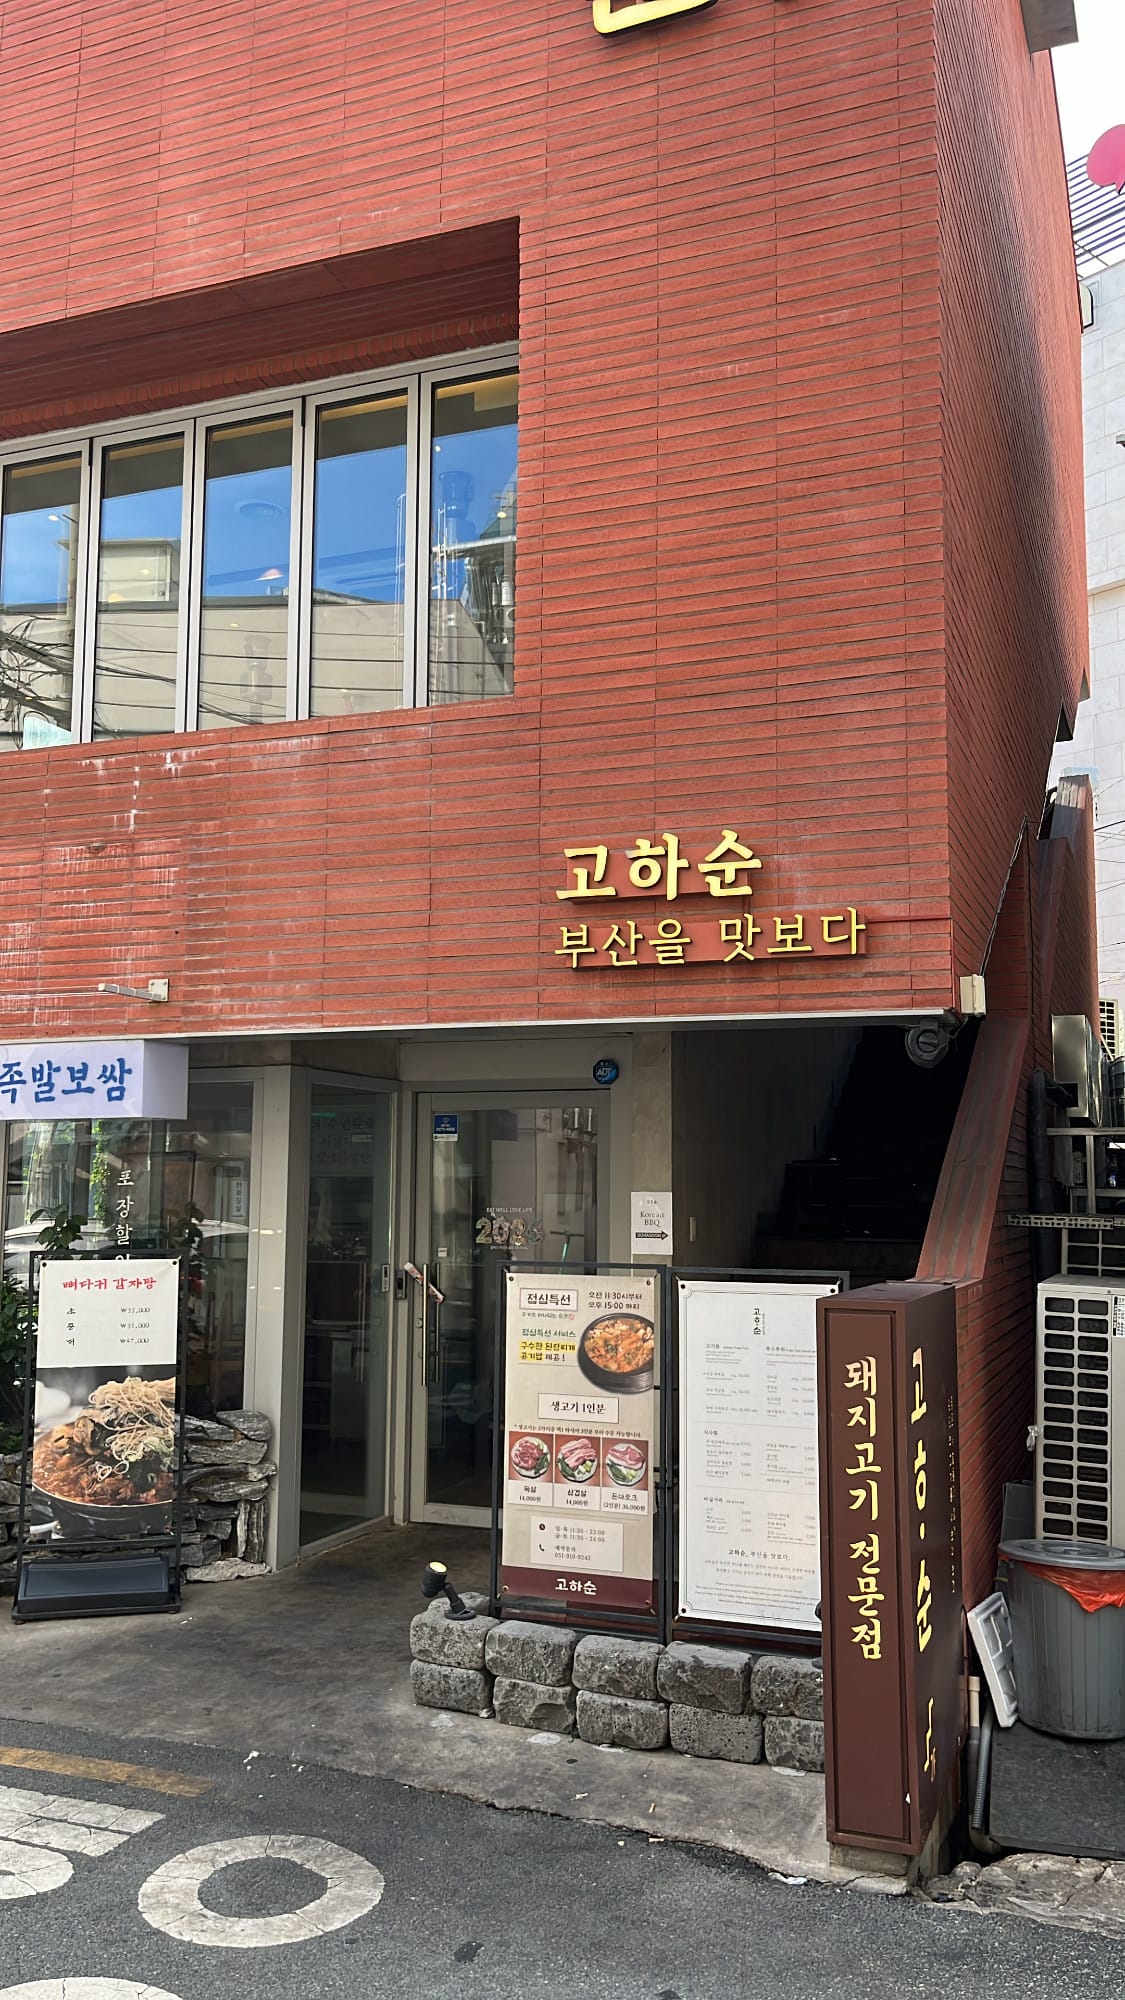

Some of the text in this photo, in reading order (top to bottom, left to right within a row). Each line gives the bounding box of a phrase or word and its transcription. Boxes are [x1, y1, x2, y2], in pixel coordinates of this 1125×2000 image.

[555, 829, 763, 901] 고하순
[554, 906, 867, 968] 부산을 맛보다
[0, 1057, 133, 1104] 족발보쌈
[640, 1210, 665, 1218] Korean
[644, 1218, 661, 1227] BBQ
[527, 1293, 571, 1306] 점심특선
[604, 1302, 624, 1310] 15:00
[551, 1402, 606, 1414] 생고기 1인분
[845, 1356, 885, 1660] 돼지고기 전문점
[555, 1578, 597, 1595] 고하순
